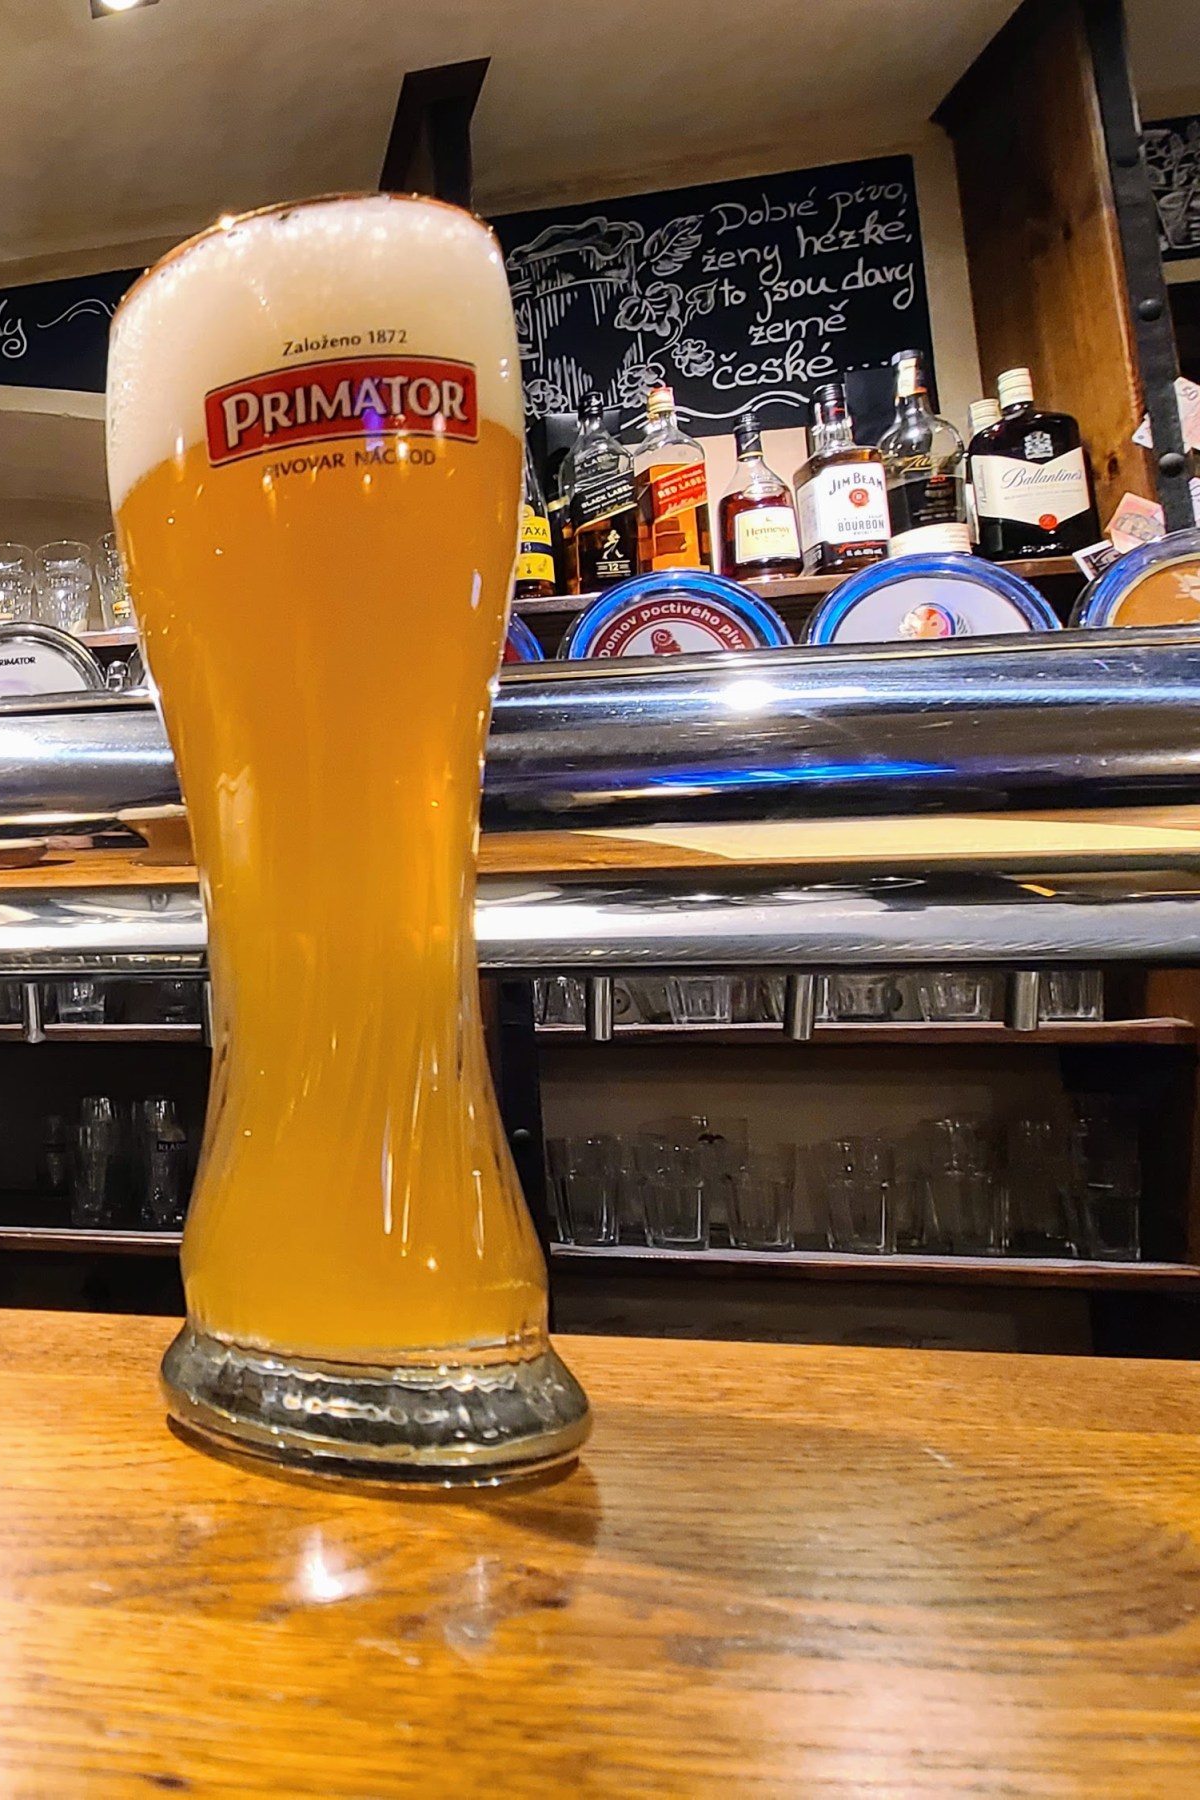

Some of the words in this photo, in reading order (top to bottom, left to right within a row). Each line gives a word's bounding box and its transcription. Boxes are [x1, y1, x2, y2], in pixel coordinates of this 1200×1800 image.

[711, 186, 818, 235] Dobré
[828, 182, 908, 235] pivo,
[702, 244, 782, 286] ženy
[797, 209, 912, 258] hezké,
[719, 278, 746, 306] to
[757, 277, 838, 323] jsou
[749, 299, 849, 345] země
[283, 333, 361, 356] Založeno
[368, 330, 407, 345] 1872
[355, 447, 435, 465] NÁCOD
[657, 486, 678, 498] RED
[829, 479, 851, 495] JIM
[853, 472, 883, 491] BEAM
[521, 526, 547, 536] AXA
[838, 520, 884, 532] BOURBON
[608, 563, 620, 571] 12
[599, 615, 637, 658] Domov
[640, 602, 720, 626] poctivého
